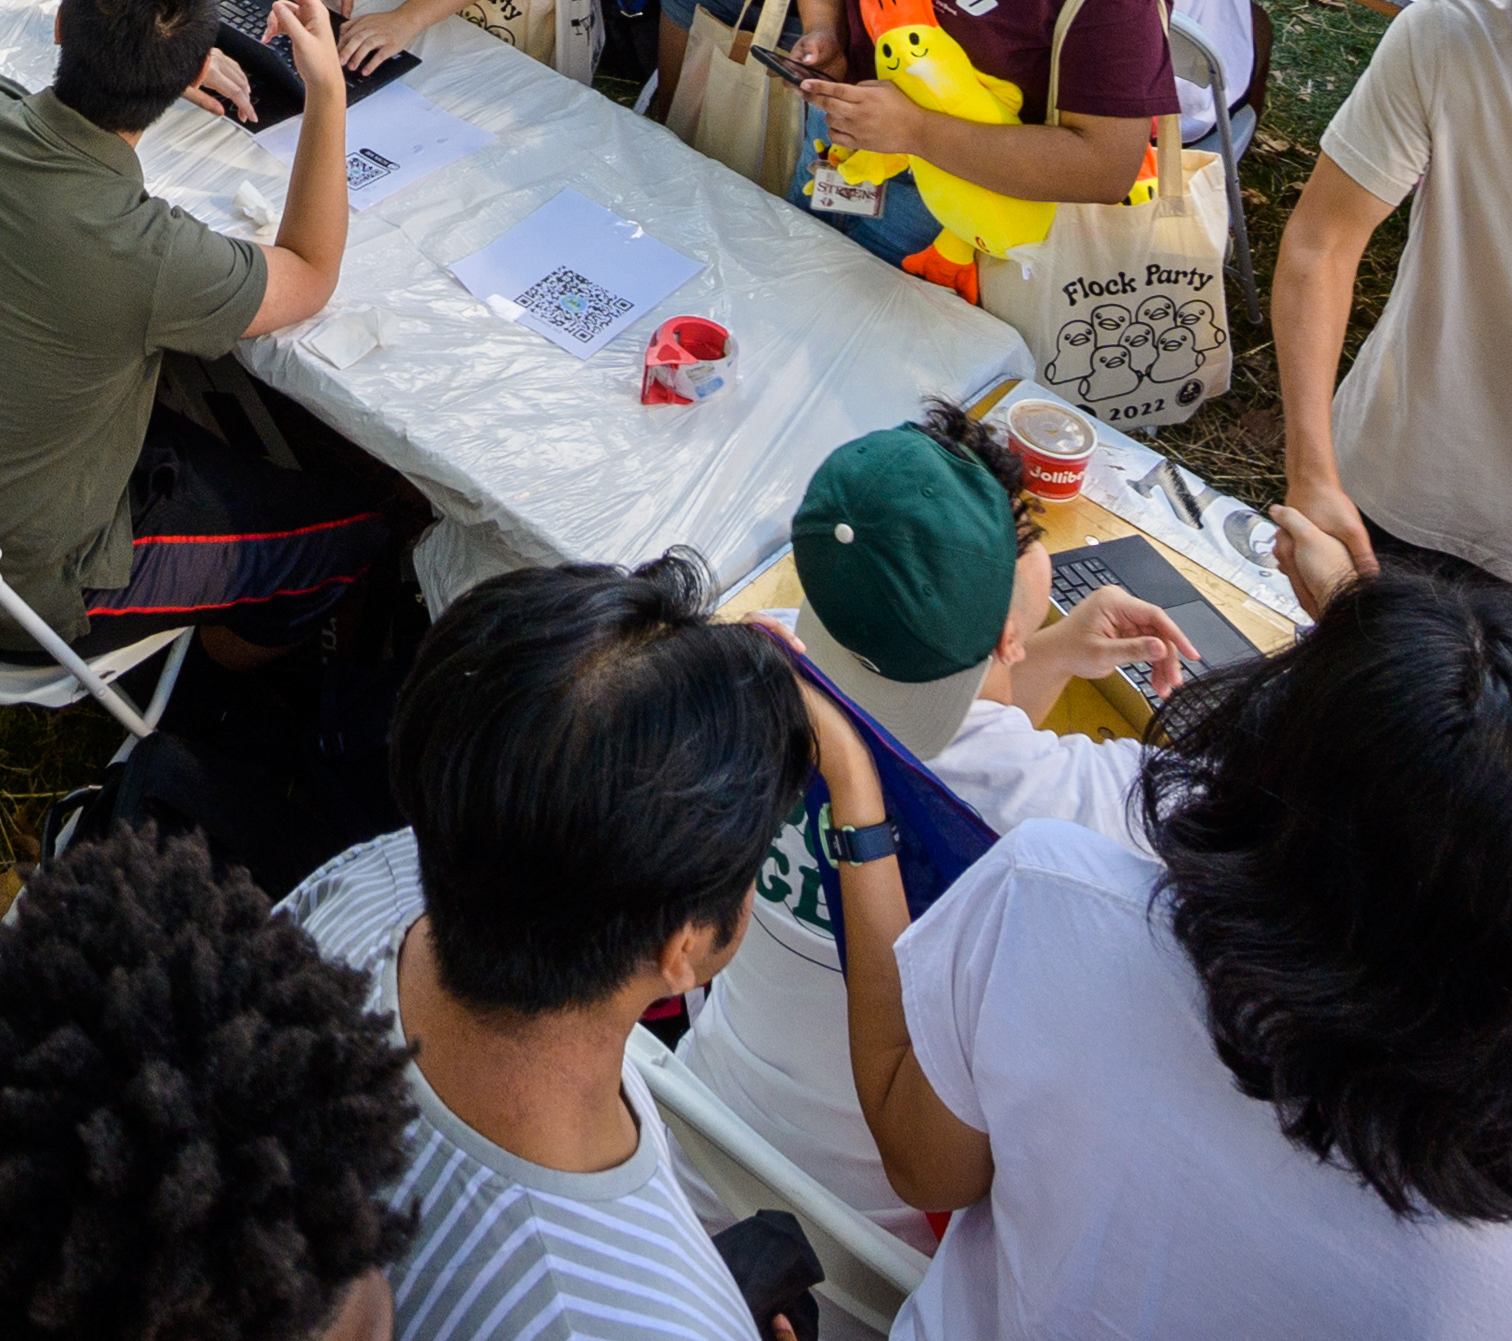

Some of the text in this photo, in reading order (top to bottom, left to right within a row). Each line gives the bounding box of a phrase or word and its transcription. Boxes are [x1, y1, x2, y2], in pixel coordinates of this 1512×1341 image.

[817, 181, 880, 201] STEVENS
[1061, 262, 1215, 307] Flock Party
[1107, 395, 1167, 423] 2022
